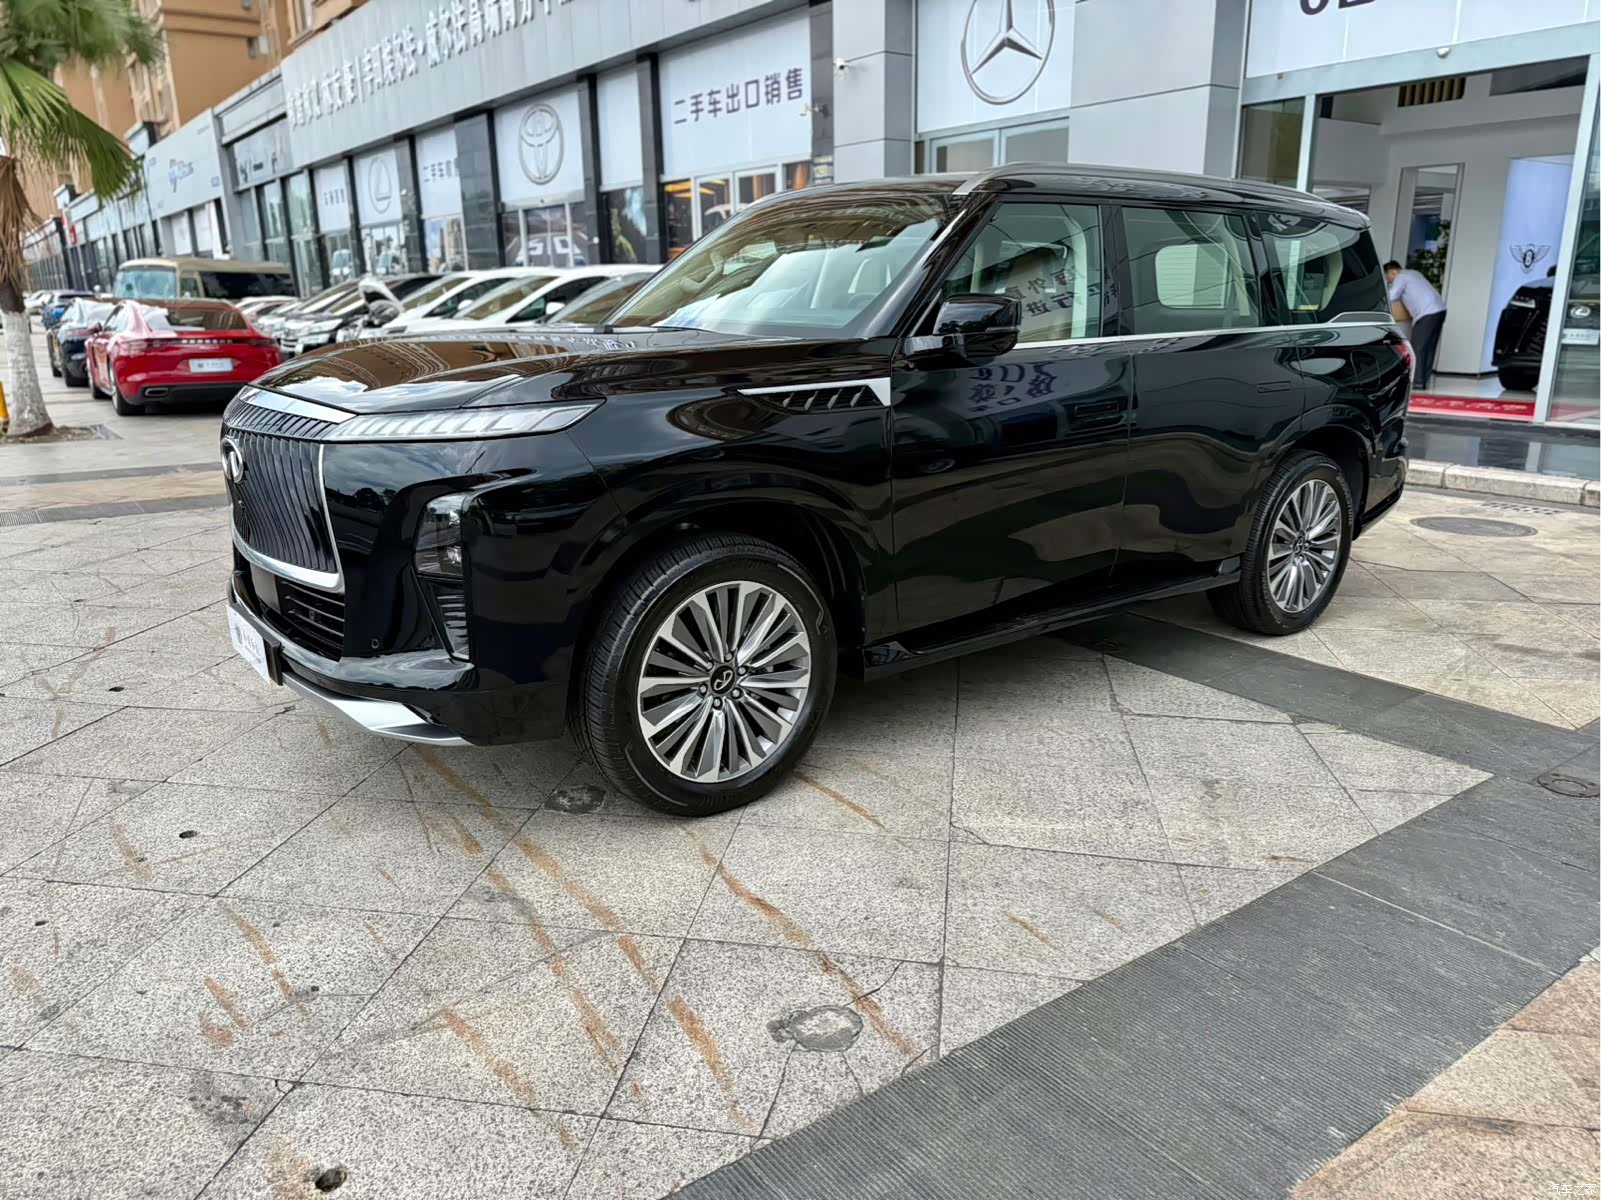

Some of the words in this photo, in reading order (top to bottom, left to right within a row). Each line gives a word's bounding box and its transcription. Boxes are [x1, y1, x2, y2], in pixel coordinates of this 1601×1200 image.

[674, 67, 803, 125] 二手车出口销售
